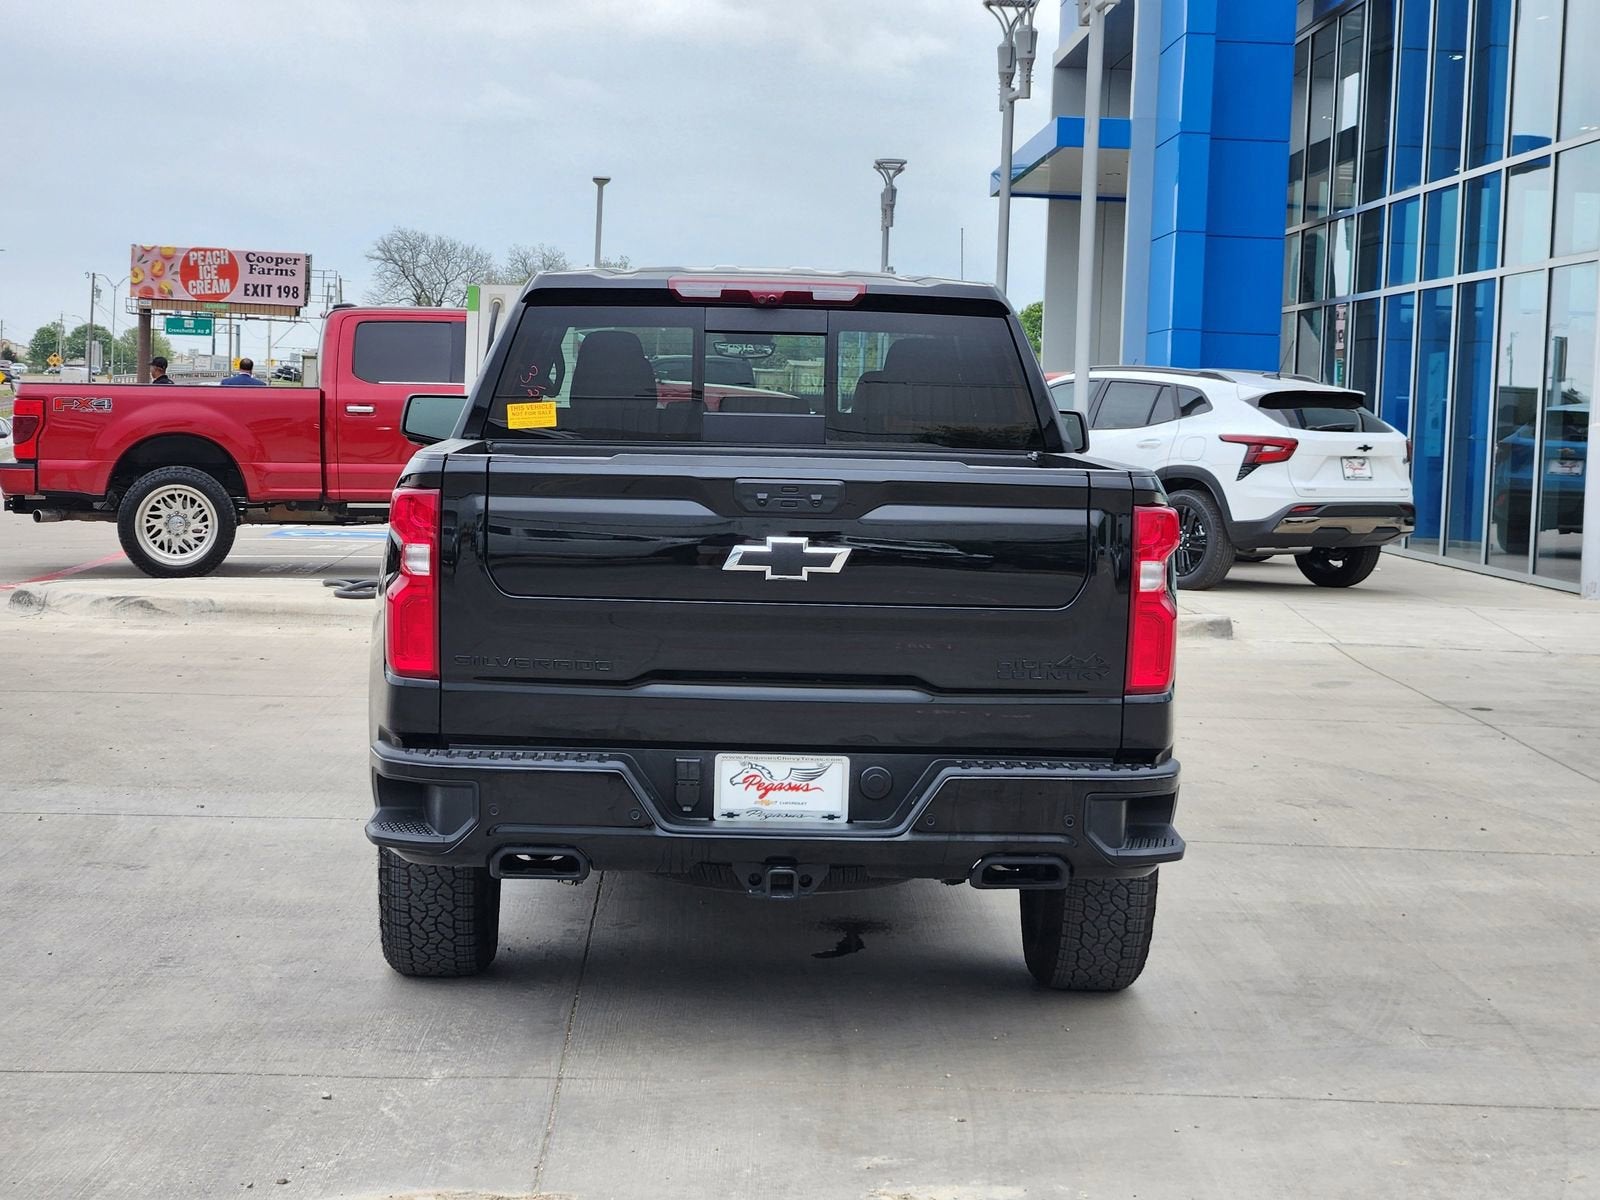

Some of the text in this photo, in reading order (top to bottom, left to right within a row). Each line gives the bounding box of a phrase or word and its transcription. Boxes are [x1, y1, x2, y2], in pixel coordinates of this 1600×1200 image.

[189, 250, 229, 265] PEACH
[245, 252, 301, 266] Cooper
[198, 265, 219, 280] ICE
[249, 264, 297, 277] Farms
[188, 279, 231, 295] CREAM
[243, 283, 299, 300] EXIT 198
[52, 396, 113, 411] FX4
[453, 654, 613, 672] SILVERADO
[996, 670, 1112, 681] COUNTRY
[742, 774, 824, 800] Pegasus
[745, 809, 814, 821] Pegasus
